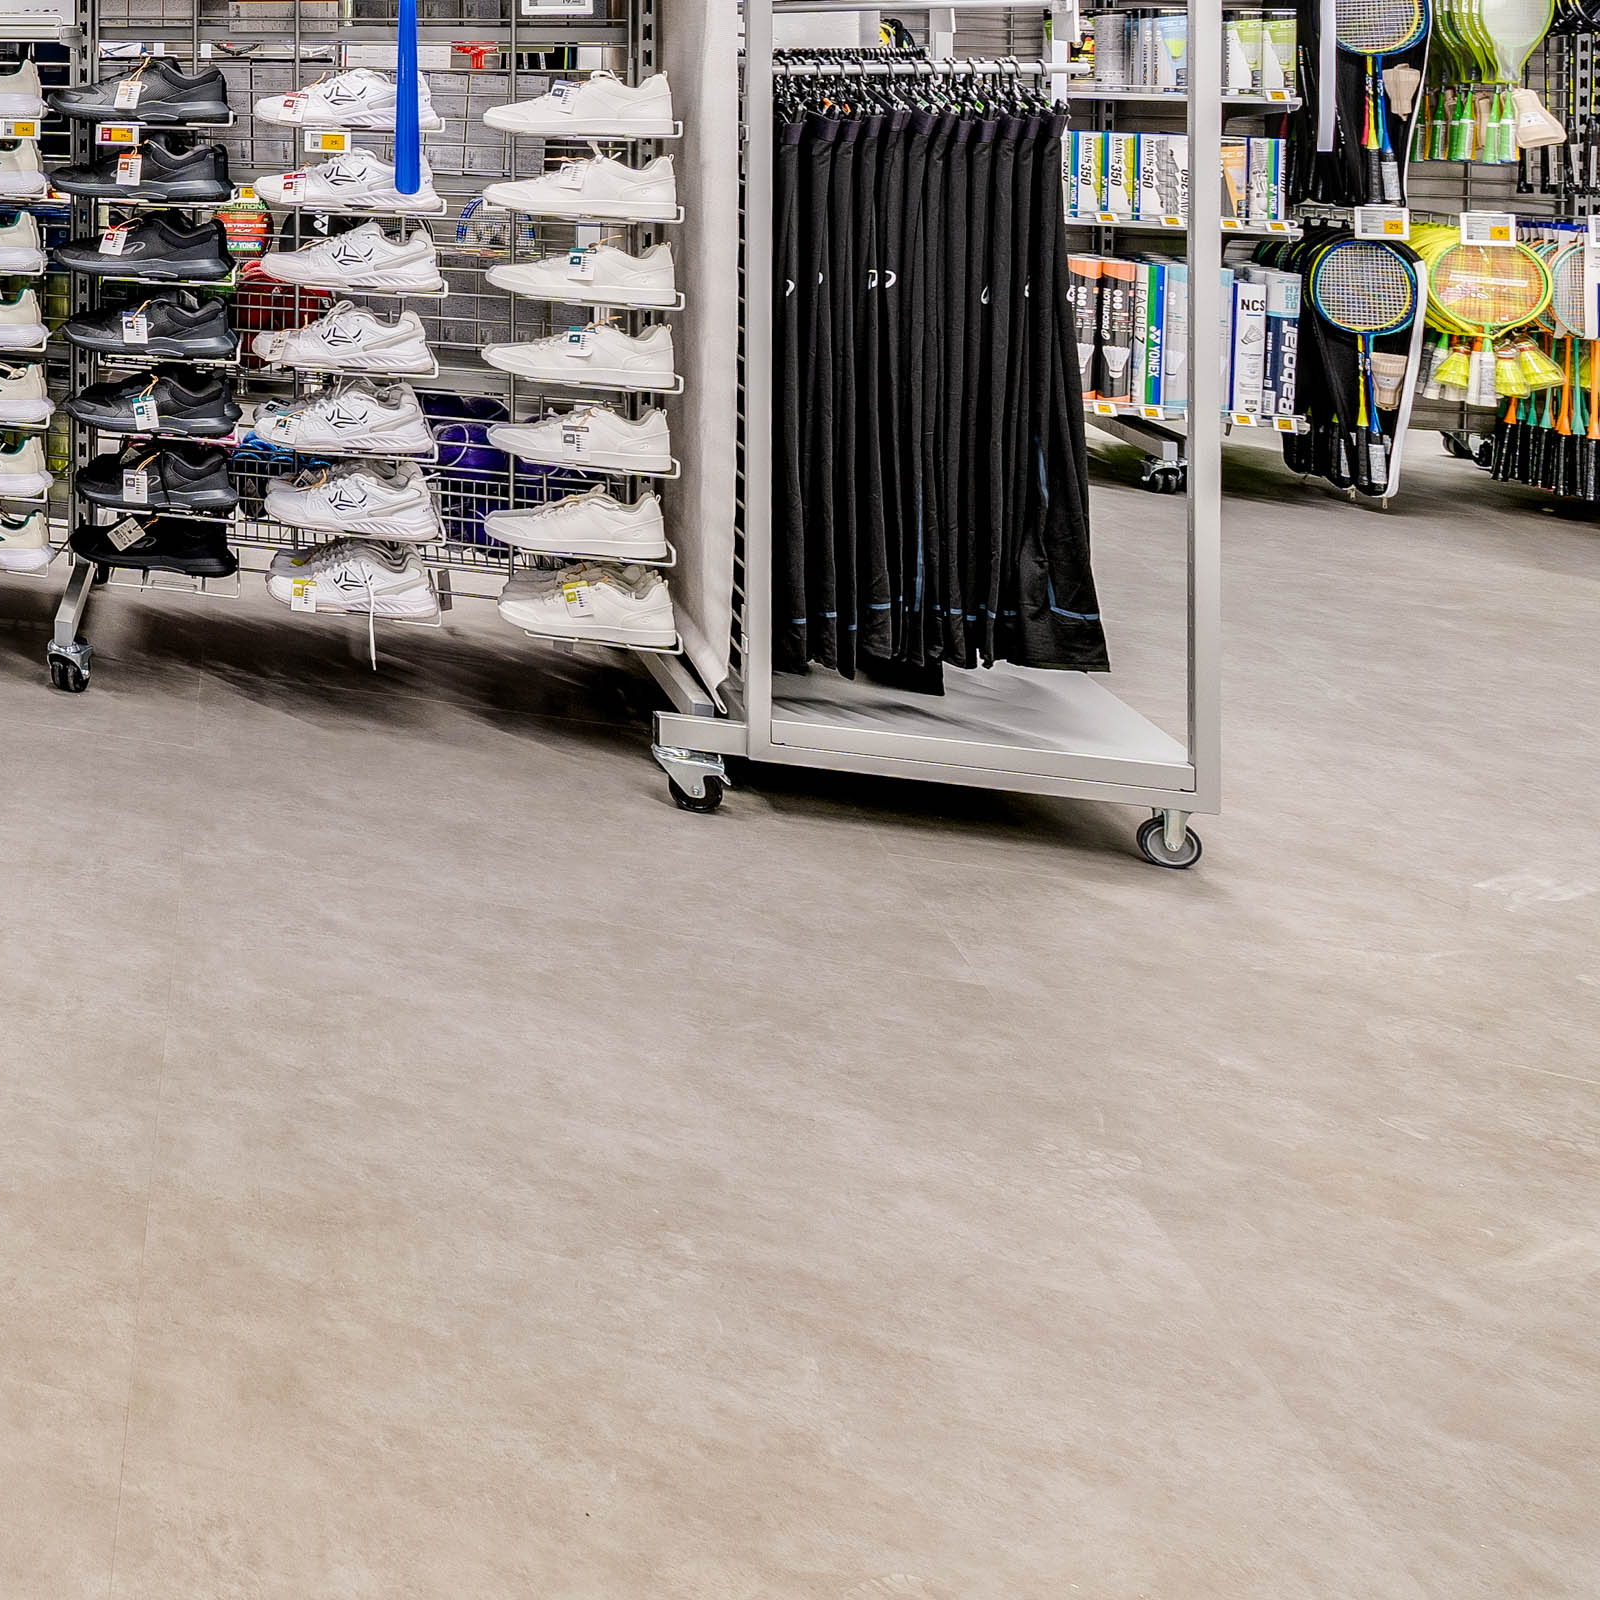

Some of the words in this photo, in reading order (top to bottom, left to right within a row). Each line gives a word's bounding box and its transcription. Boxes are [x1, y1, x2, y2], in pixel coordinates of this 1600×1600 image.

[1080, 162, 1092, 186] 350
[1111, 163, 1122, 187] 350
[1143, 166, 1154, 189] 350
[1240, 299, 1265, 312] NCS
[1148, 346, 1161, 378] YONEX
